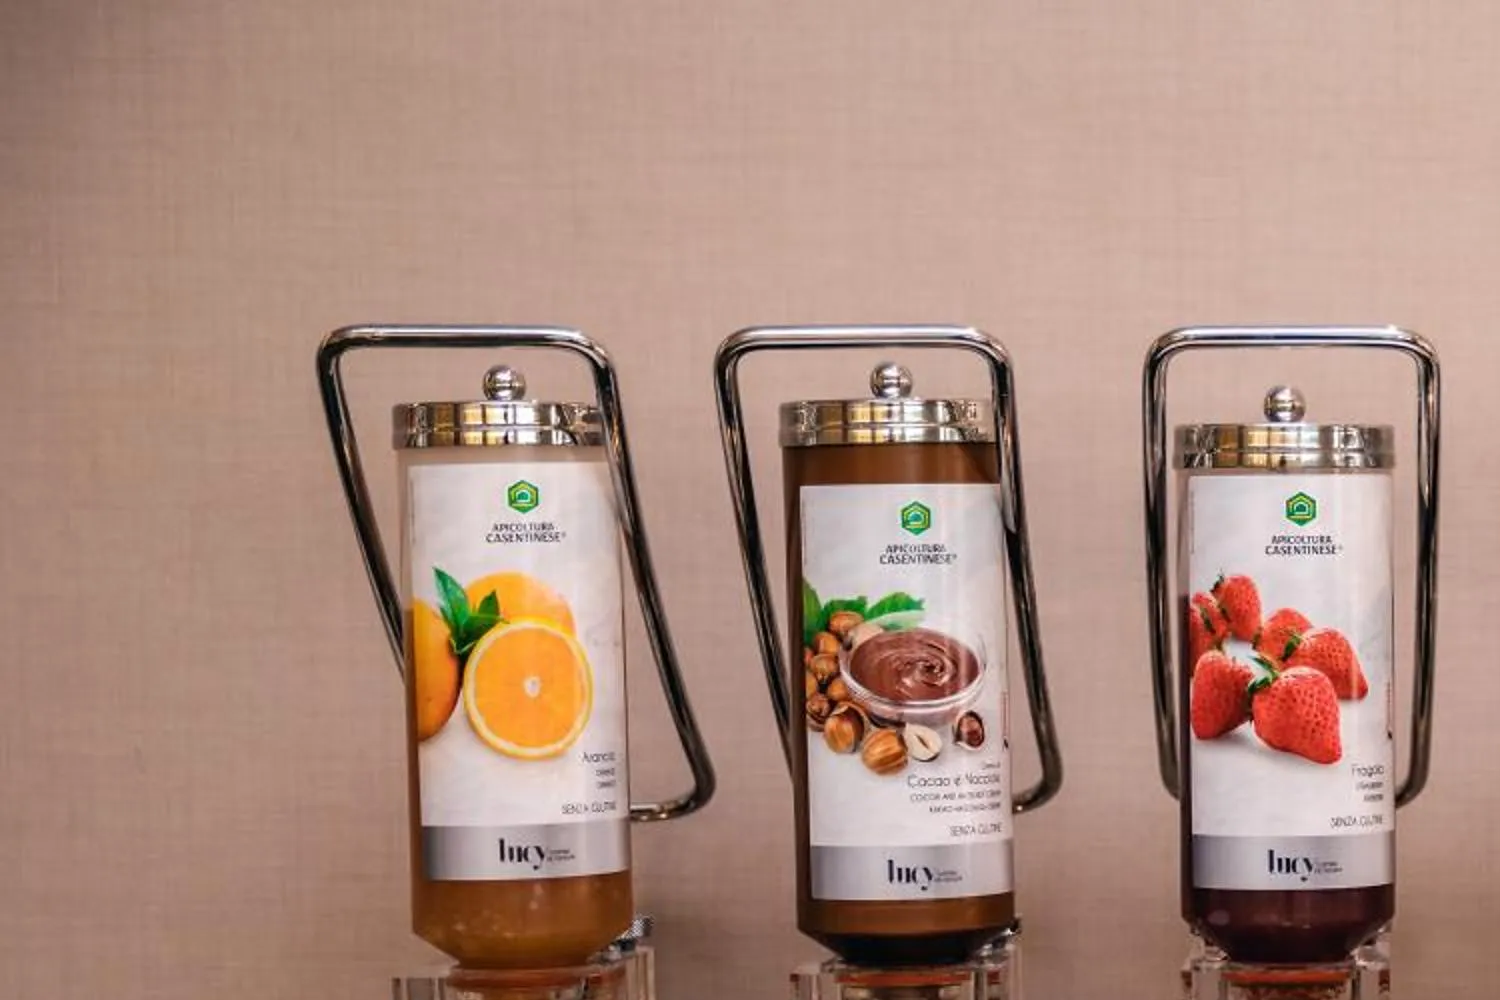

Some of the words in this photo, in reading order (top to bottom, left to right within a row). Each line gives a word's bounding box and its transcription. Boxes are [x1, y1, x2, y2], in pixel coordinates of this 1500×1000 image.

[492, 522, 555, 532] APICOLTURA
[1271, 535, 1332, 545] APICOLTURA
[886, 543, 947, 553] APICOLTURA
[907, 775, 951, 788] Cacao
